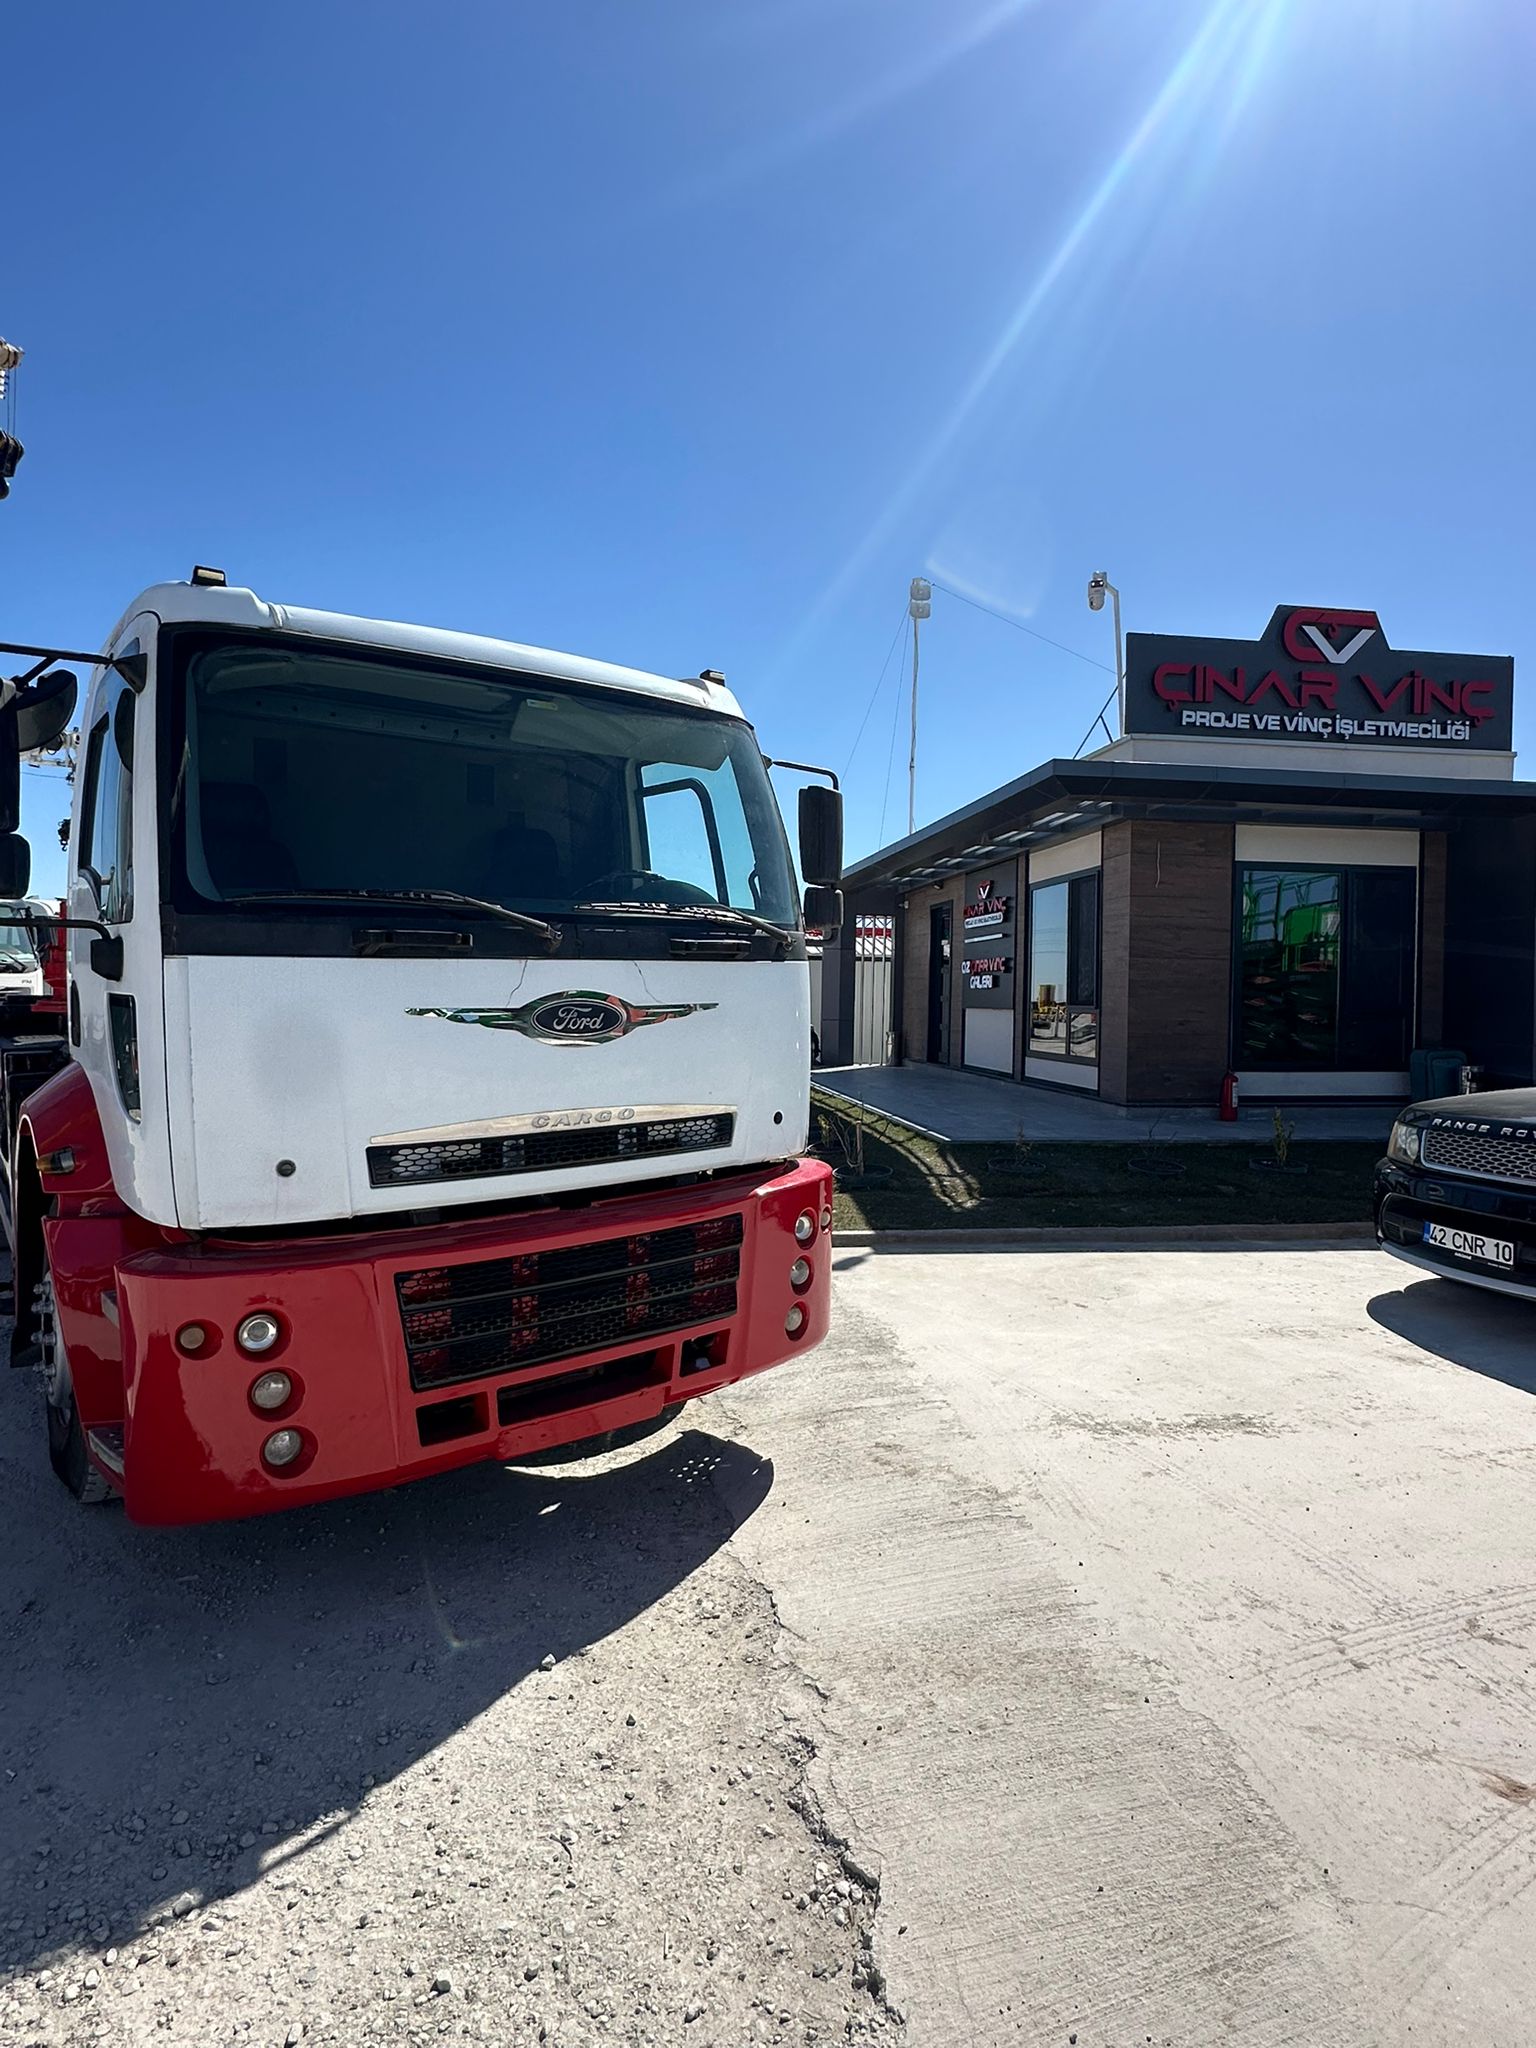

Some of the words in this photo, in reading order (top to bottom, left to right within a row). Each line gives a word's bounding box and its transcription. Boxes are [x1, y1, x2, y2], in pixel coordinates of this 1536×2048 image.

[1154, 663, 1338, 712] ÇINAR
[1357, 670, 1496, 726] VİNÇ
[1182, 710, 1250, 729] PROJE
[1253, 714, 1281, 731] VE
[1283, 711, 1332, 739] VİNÇ
[1336, 714, 1470, 741] İŞLETMECİLİĞİ
[553, 1006, 604, 1030] Ford
[531, 1108, 635, 1129] CARGO
[1432, 1118, 1490, 1133] RANGE
[1430, 1226, 1447, 1246] 42
[1452, 1232, 1485, 1256] CNR
[1494, 1242, 1512, 1262] 10
